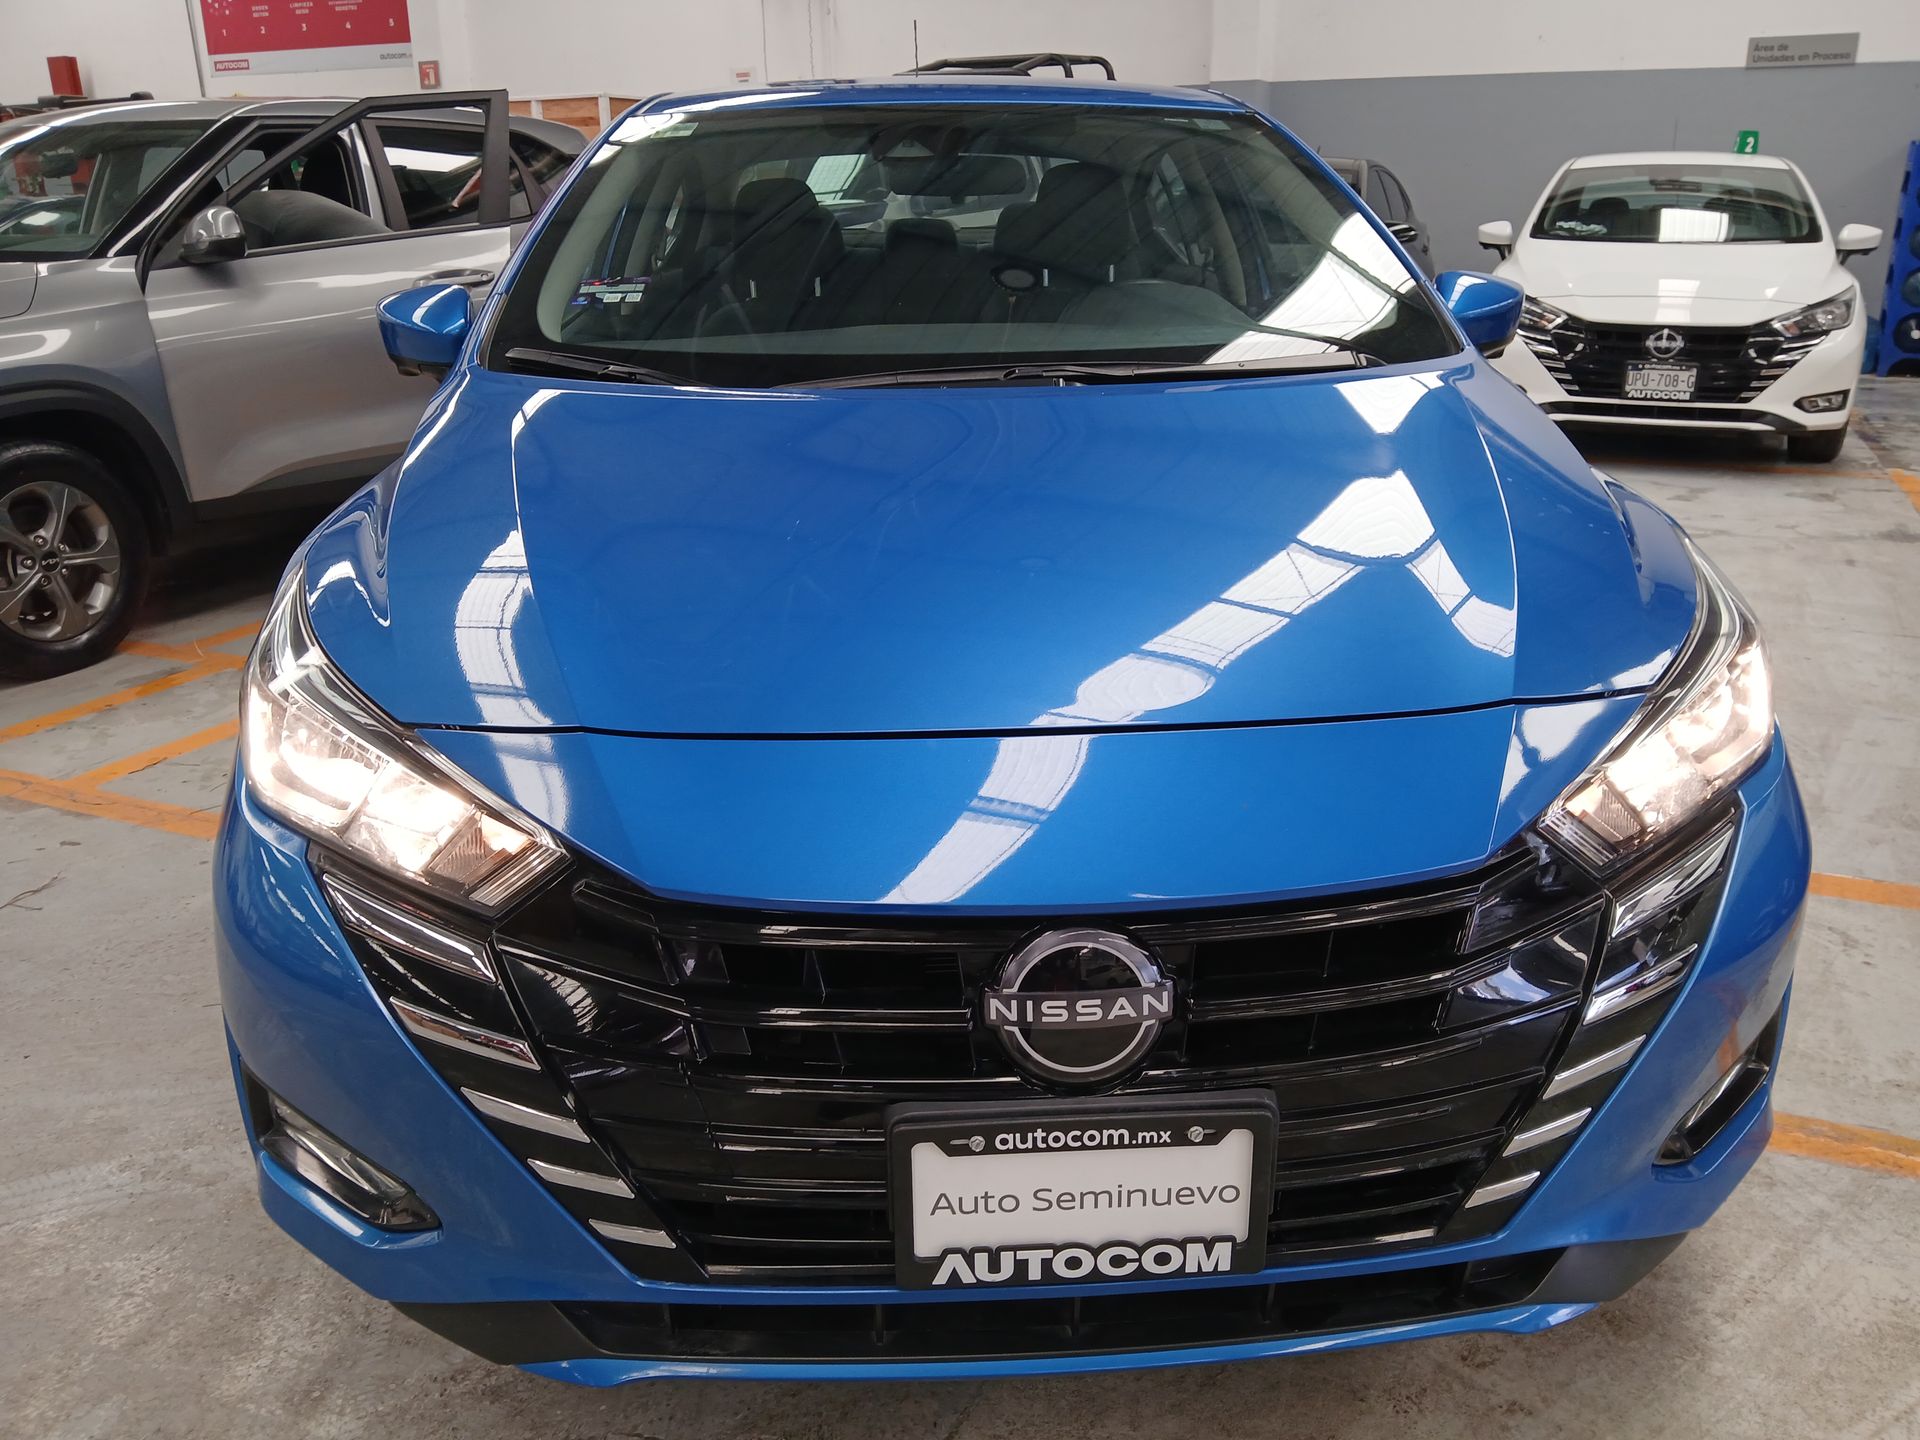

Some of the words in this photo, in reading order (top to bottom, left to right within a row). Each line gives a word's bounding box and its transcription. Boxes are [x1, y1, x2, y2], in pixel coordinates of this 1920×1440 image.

[301, 23, 307, 31] 3
[345, 21, 351, 29] 4
[388, 18, 395, 27] 5
[222, 29, 227, 37] 1
[260, 26, 266, 34] 2
[1777, 43, 1789, 51] de
[1752, 53, 1795, 63] Unidades
[1812, 51, 1851, 61] Proceso
[216, 61, 248, 70] AUTOCOM
[1744, 136, 1755, 153] 2
[1626, 372, 1695, 389] UPU-708-G
[1627, 389, 1691, 400] AUTOCOM
[989, 990, 1170, 1024] NISSAN
[994, 1128, 1172, 1151] autocom.mx
[929, 1190, 1020, 1216] Auto
[1032, 1184, 1241, 1213] Seminuevo
[931, 1241, 1233, 1286] AUTOCOM
